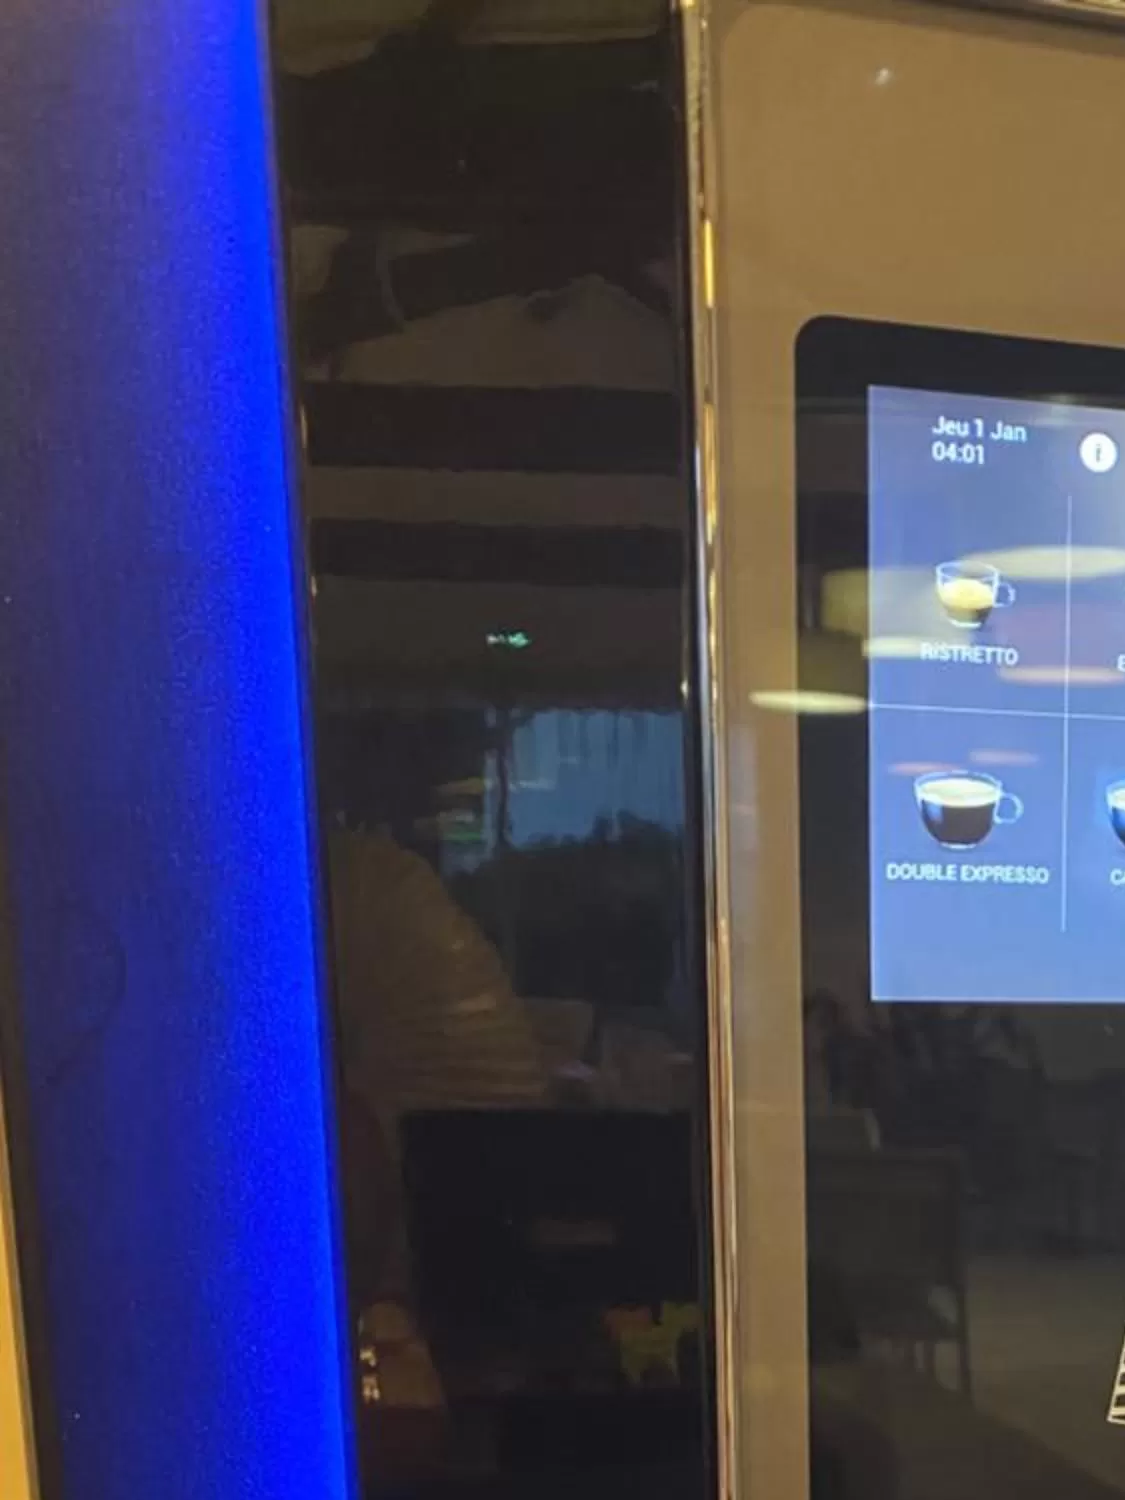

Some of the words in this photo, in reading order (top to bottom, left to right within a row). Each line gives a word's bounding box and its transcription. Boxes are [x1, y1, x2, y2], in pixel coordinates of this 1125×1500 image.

[933, 417, 969, 436] Jeu
[974, 419, 984, 437] 1
[990, 421, 1027, 442] Jan
[931, 443, 985, 464] 04:01
[920, 644, 1018, 665] RISTRETTO
[887, 864, 957, 883] DOUBLE
[960, 865, 1050, 885] EXPRESSO
